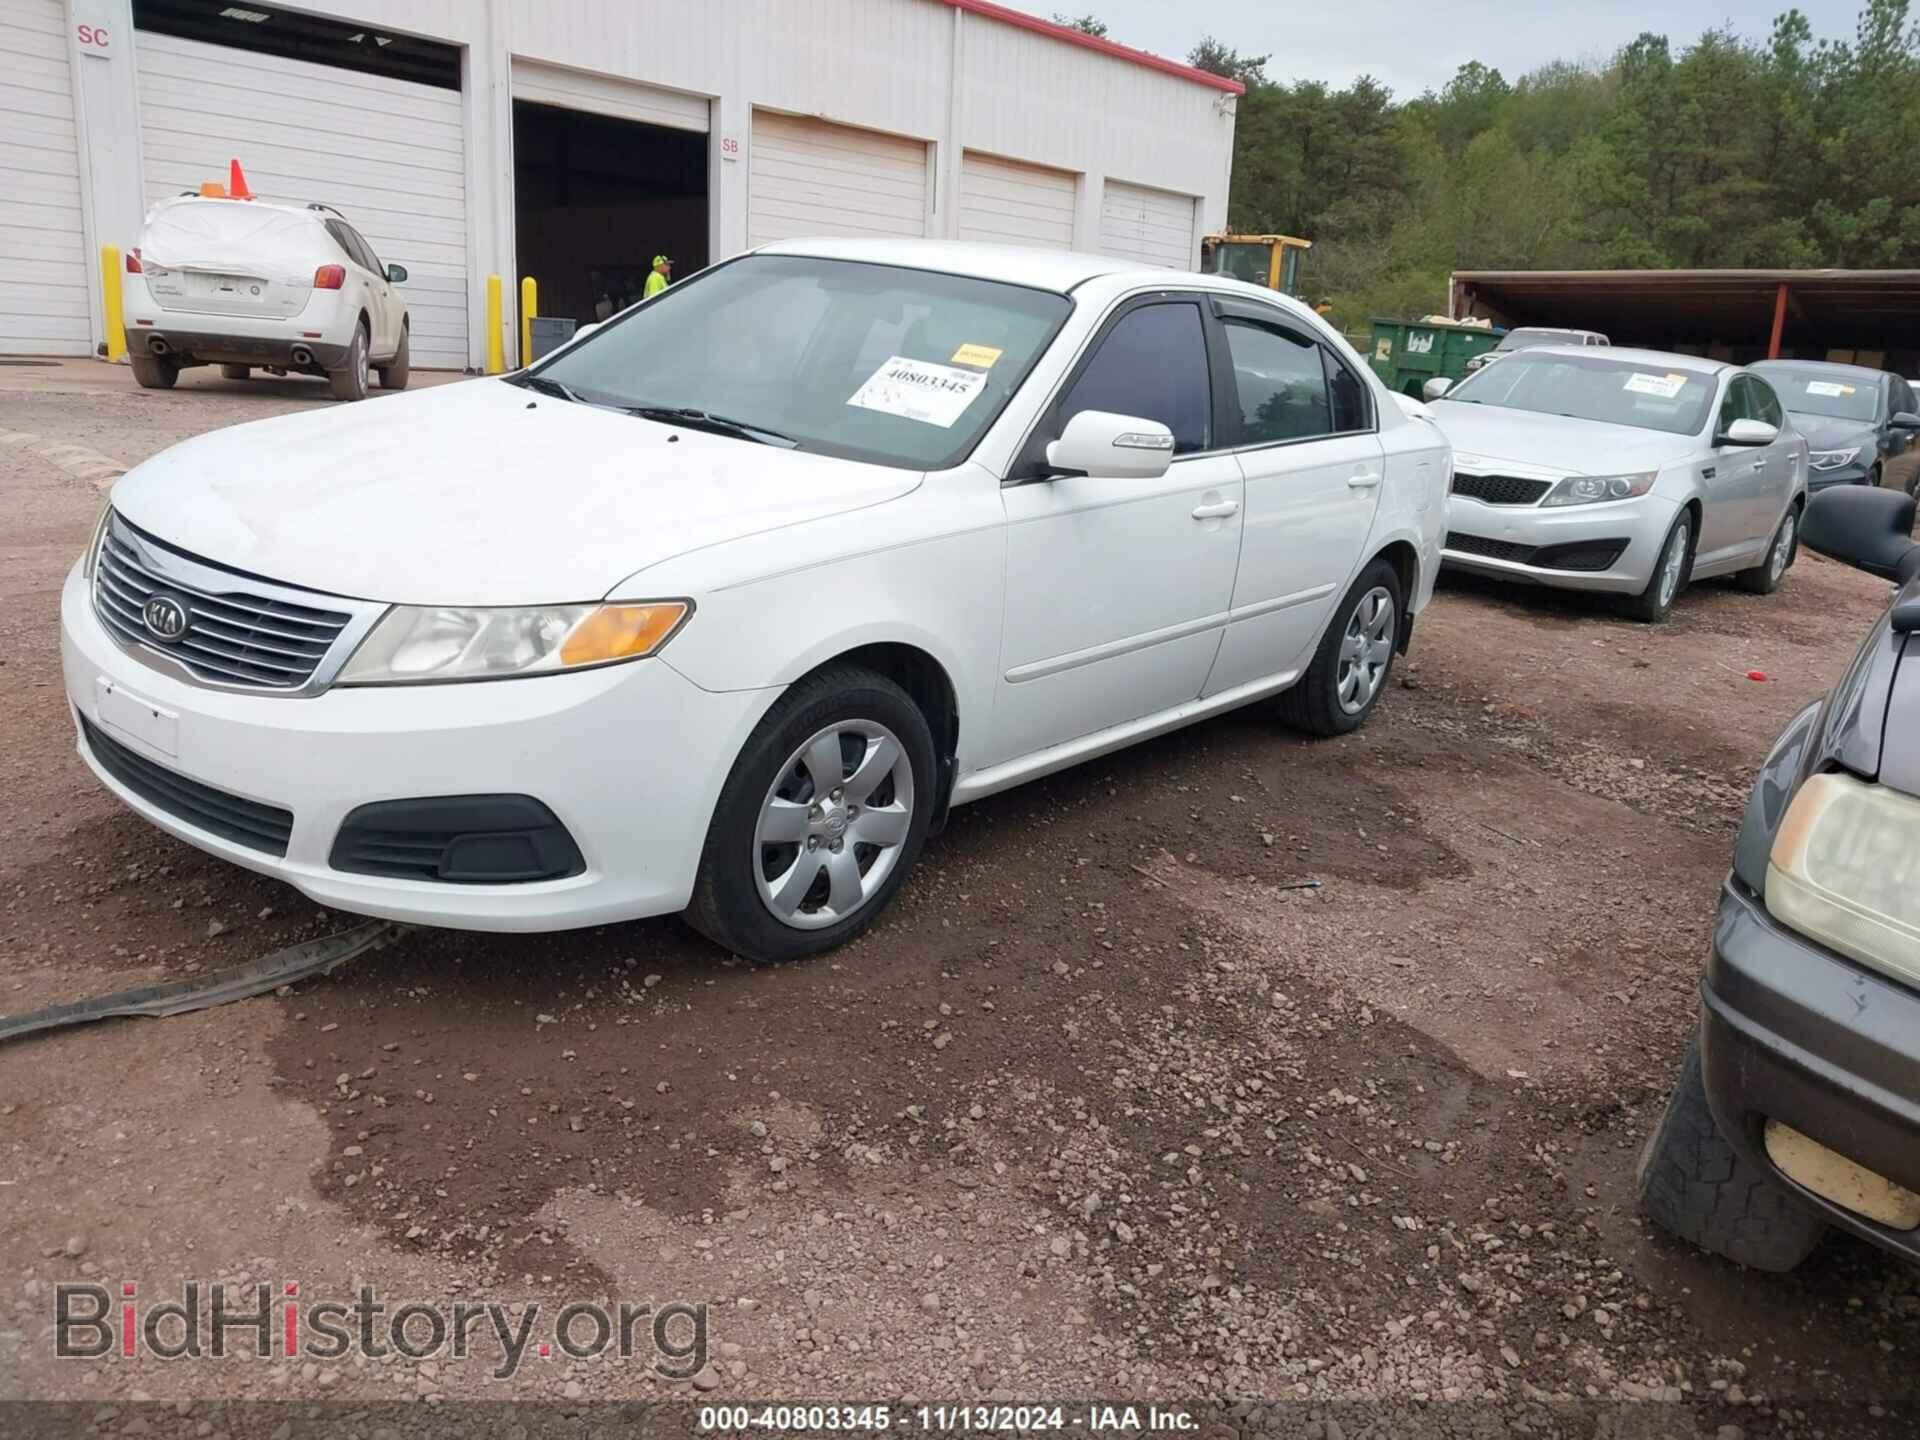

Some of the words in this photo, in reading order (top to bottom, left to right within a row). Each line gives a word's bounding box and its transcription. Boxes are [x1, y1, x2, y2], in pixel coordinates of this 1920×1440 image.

[77, 24, 109, 48] SC
[723, 138, 738, 153] SB
[887, 368, 969, 394] 40803345
[149, 602, 176, 633] KIA
